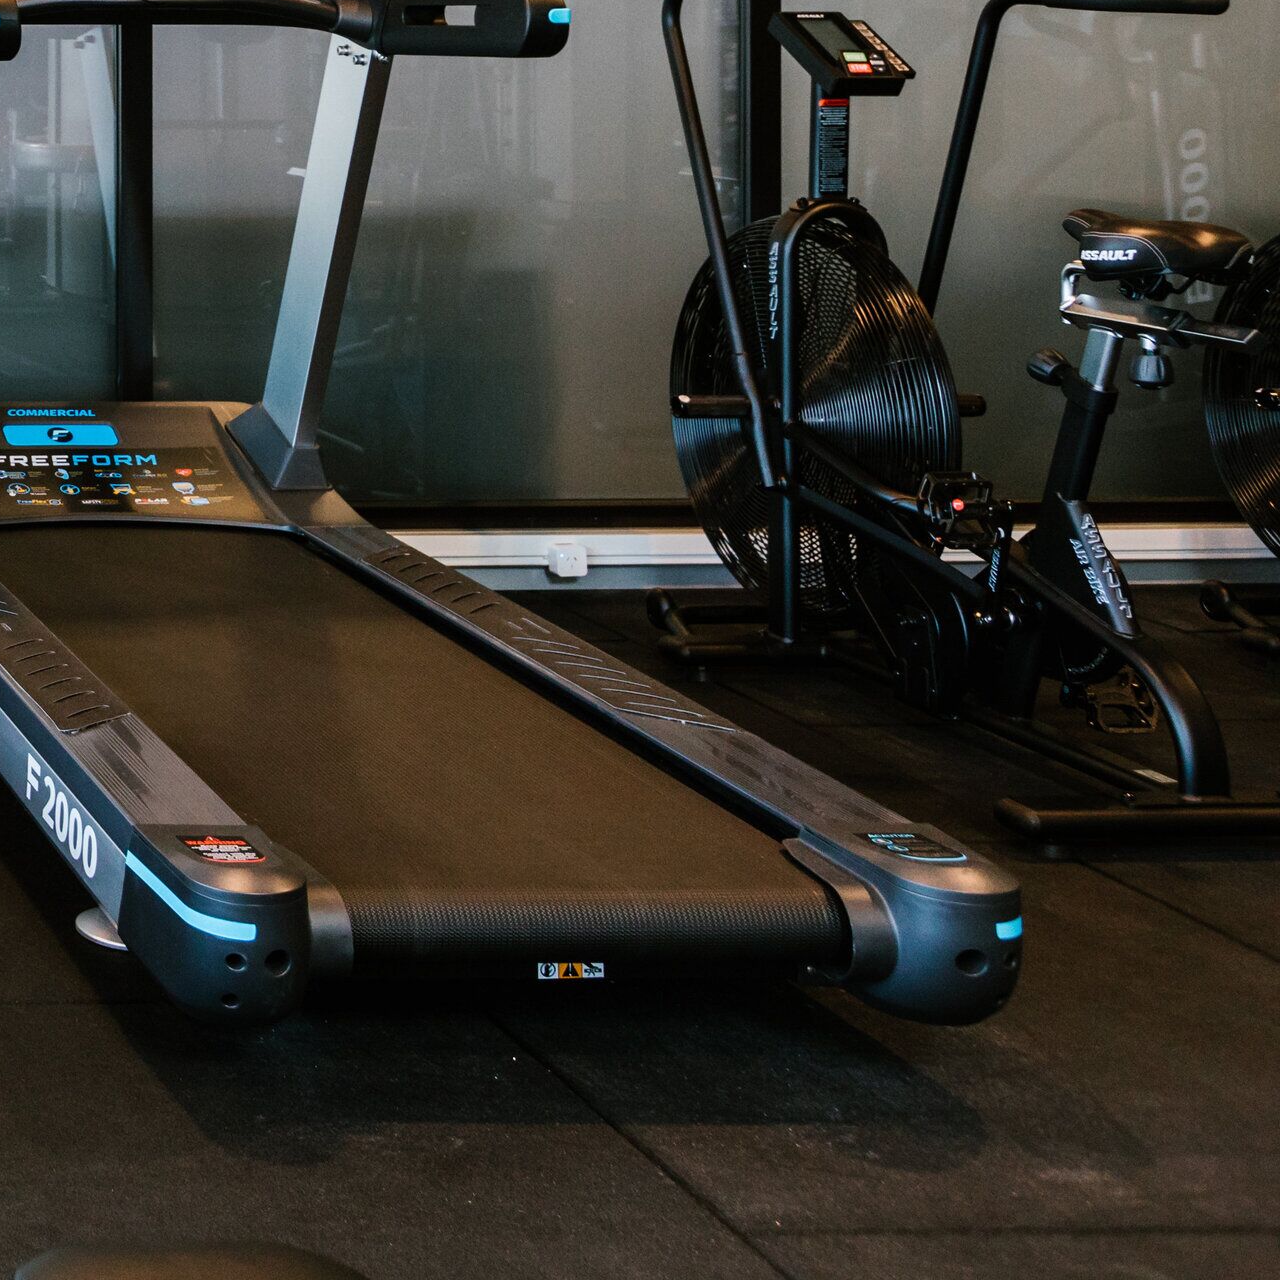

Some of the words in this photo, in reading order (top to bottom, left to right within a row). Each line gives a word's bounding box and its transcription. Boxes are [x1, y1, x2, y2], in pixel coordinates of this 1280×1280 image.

[768, 241, 780, 339] ASSAULT
[7, 408, 96, 417] COMMERCIAL
[1069, 538, 1090, 565] AIR
[26, 753, 41, 800] F
[42, 776, 98, 878] 2000
